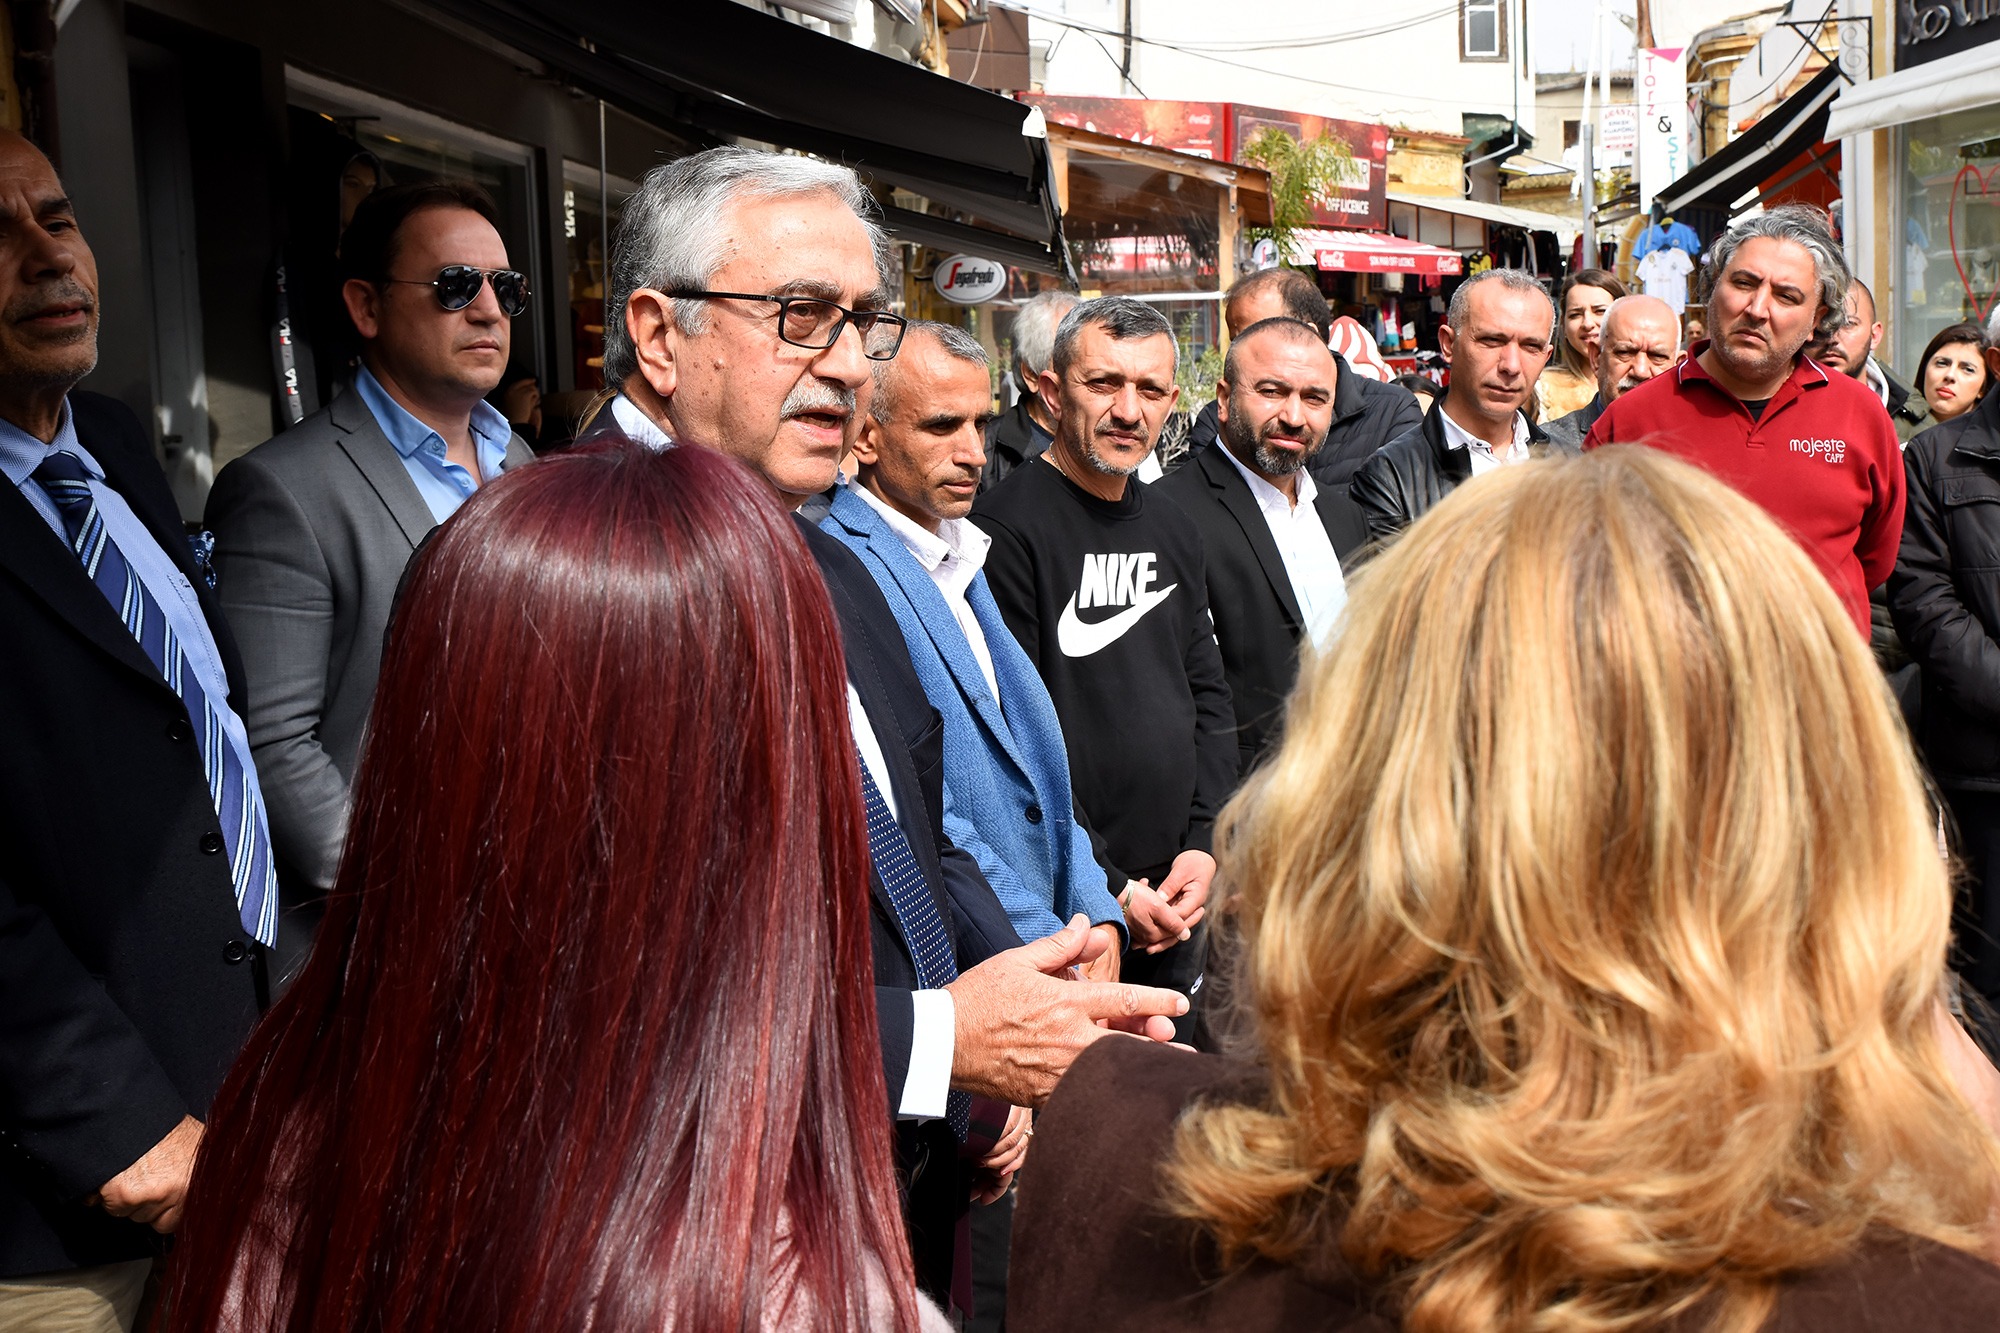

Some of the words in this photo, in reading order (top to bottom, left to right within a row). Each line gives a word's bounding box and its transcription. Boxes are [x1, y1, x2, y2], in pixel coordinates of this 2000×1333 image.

[1644, 56, 1656, 116] Tarz
[1657, 115, 1672, 133] &
[1325, 197, 1340, 212] OFF
[1340, 198, 1370, 215] LICENCE
[943, 262, 995, 290] Segafredo
[279, 317, 292, 345] FILA
[284, 367, 299, 395] FILA
[1789, 437, 1846, 458] majeste
[1078, 552, 1157, 609] NIKE
